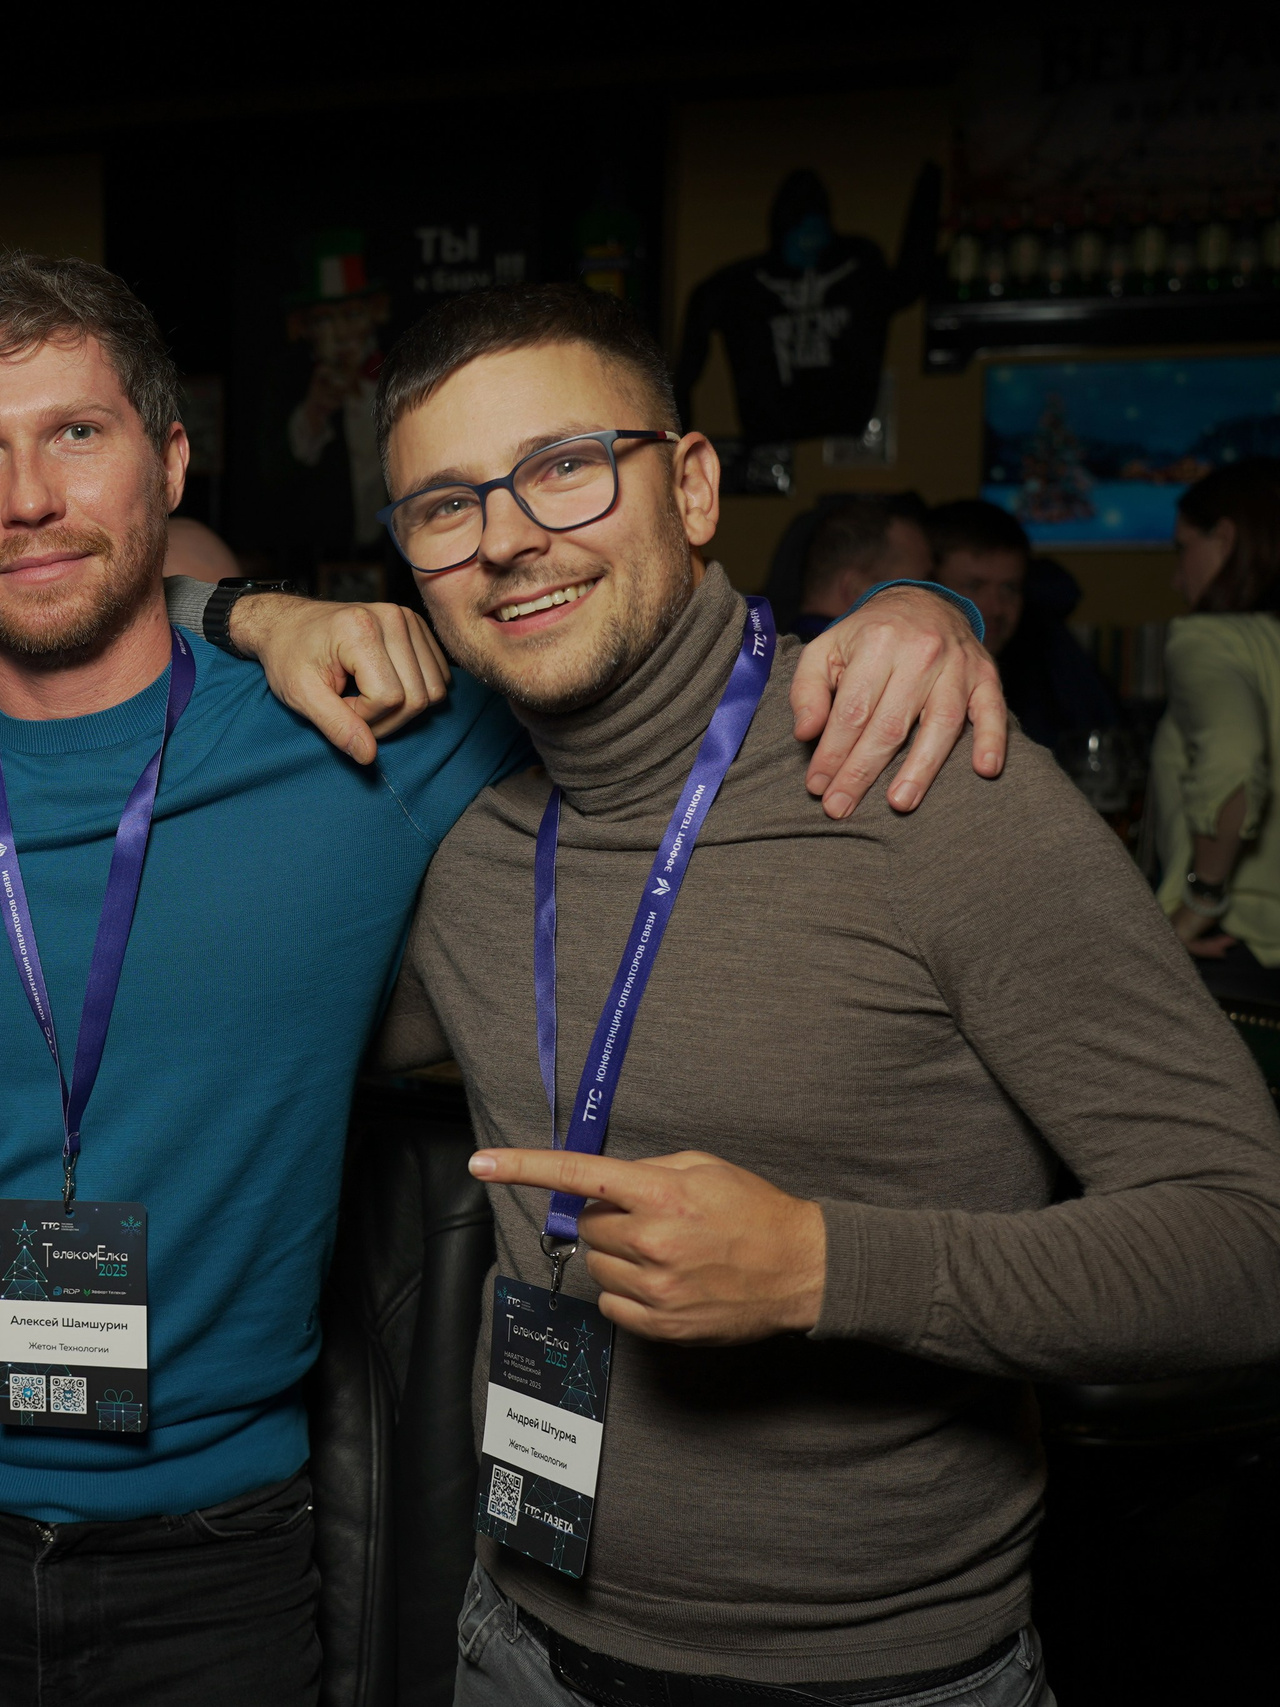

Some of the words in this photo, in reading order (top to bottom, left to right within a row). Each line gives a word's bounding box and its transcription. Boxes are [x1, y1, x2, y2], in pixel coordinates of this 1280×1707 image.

[752, 633, 767, 657] ТТС
[663, 831, 686, 873] ЭФФОРТ
[680, 784, 706, 830] ТЕЛЕКОМ
[1, 870, 14, 898] СВЯЗИ
[8, 899, 27, 955] ОПЕРАТОРОВ
[21, 956, 45, 1021] КОНФЕРЕНЦИЯ
[583, 1088, 602, 1122] ТТС
[595, 1009, 623, 1082] КОНФЕРЕНЦИЯ
[618, 945, 646, 1009] ОПЕРАТОРОВ
[641, 911, 657, 944] СВЯЗИ
[98, 1264, 128, 1277] 2025
[10, 1315, 59, 1328] Алексей
[62, 1318, 128, 1333] Шамшурин
[29, 1342, 57, 1351] Жетон
[58, 1343, 110, 1354] Технологии
[545, 1348, 567, 1369] 2025
[525, 1357, 536, 1367] PUB
[529, 1379, 542, 1390] 2025
[506, 1407, 539, 1433] Андрей
[541, 1420, 577, 1445] Штурма
[509, 1438, 530, 1455] Жетон
[530, 1446, 568, 1470] Технологии
